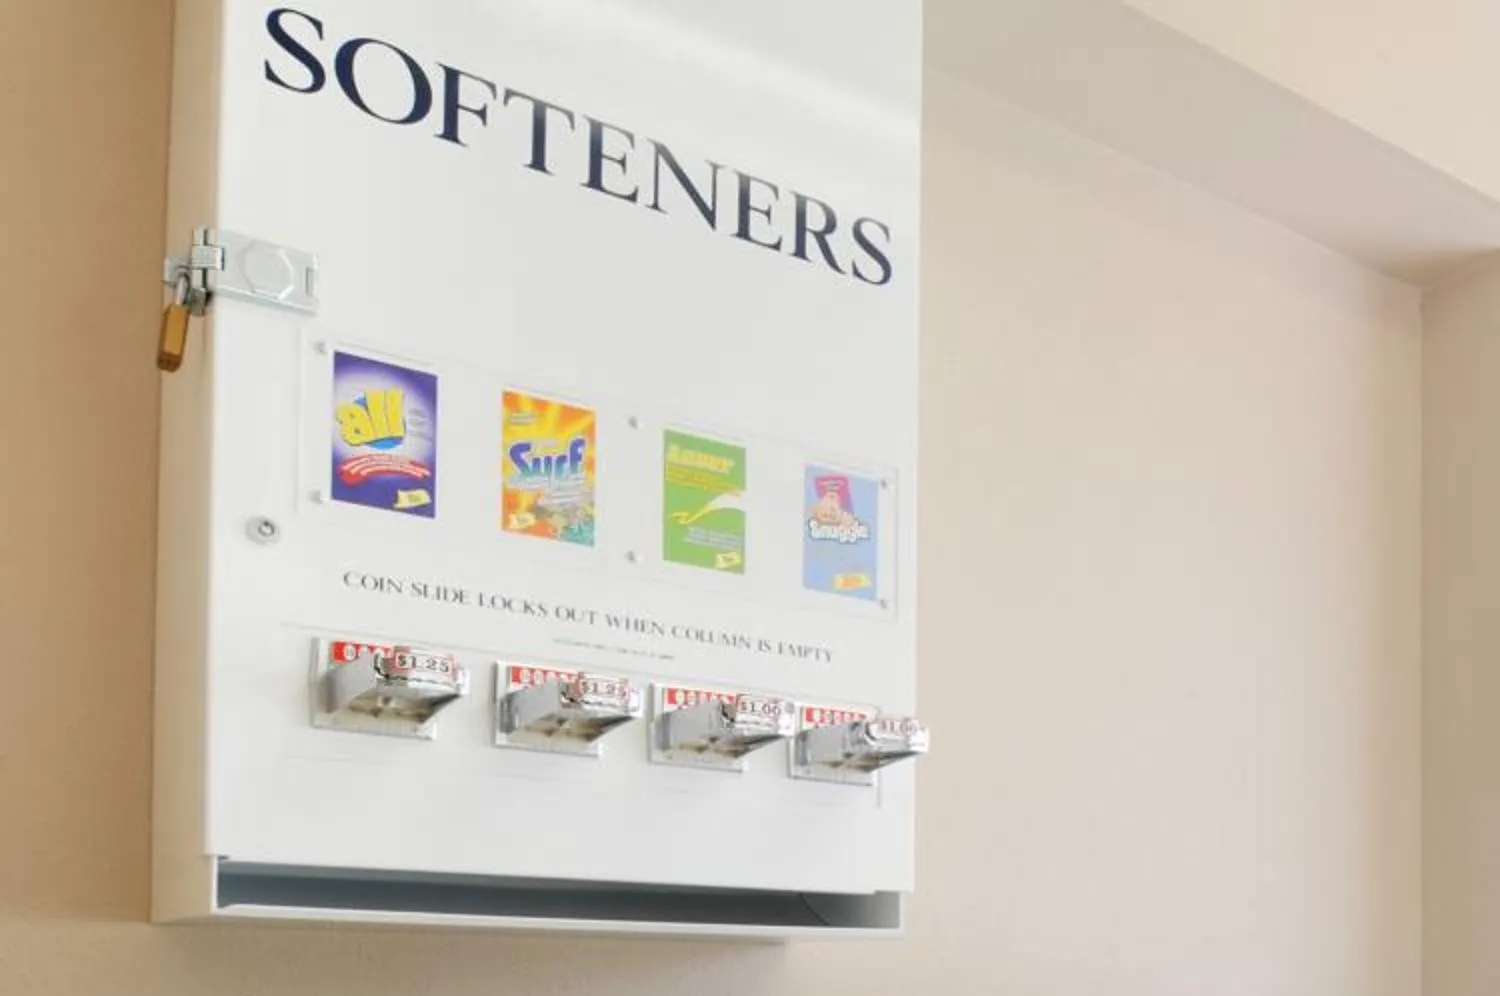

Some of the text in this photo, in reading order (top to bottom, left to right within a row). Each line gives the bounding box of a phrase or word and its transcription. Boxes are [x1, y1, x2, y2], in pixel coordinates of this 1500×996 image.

[264, 7, 894, 287] SOFTENERS
[509, 437, 586, 477] Surf
[343, 571, 403, 594] COIN
[411, 582, 472, 606] SLIDE
[479, 591, 548, 618] LOCKS
[554, 604, 598, 626] OUT
[604, 613, 665, 638] WHEN
[671, 624, 751, 650] COLUMN
[757, 639, 771, 653] IS
[776, 640, 833, 663] EMPTY
[397, 652, 449, 673] $1.25
